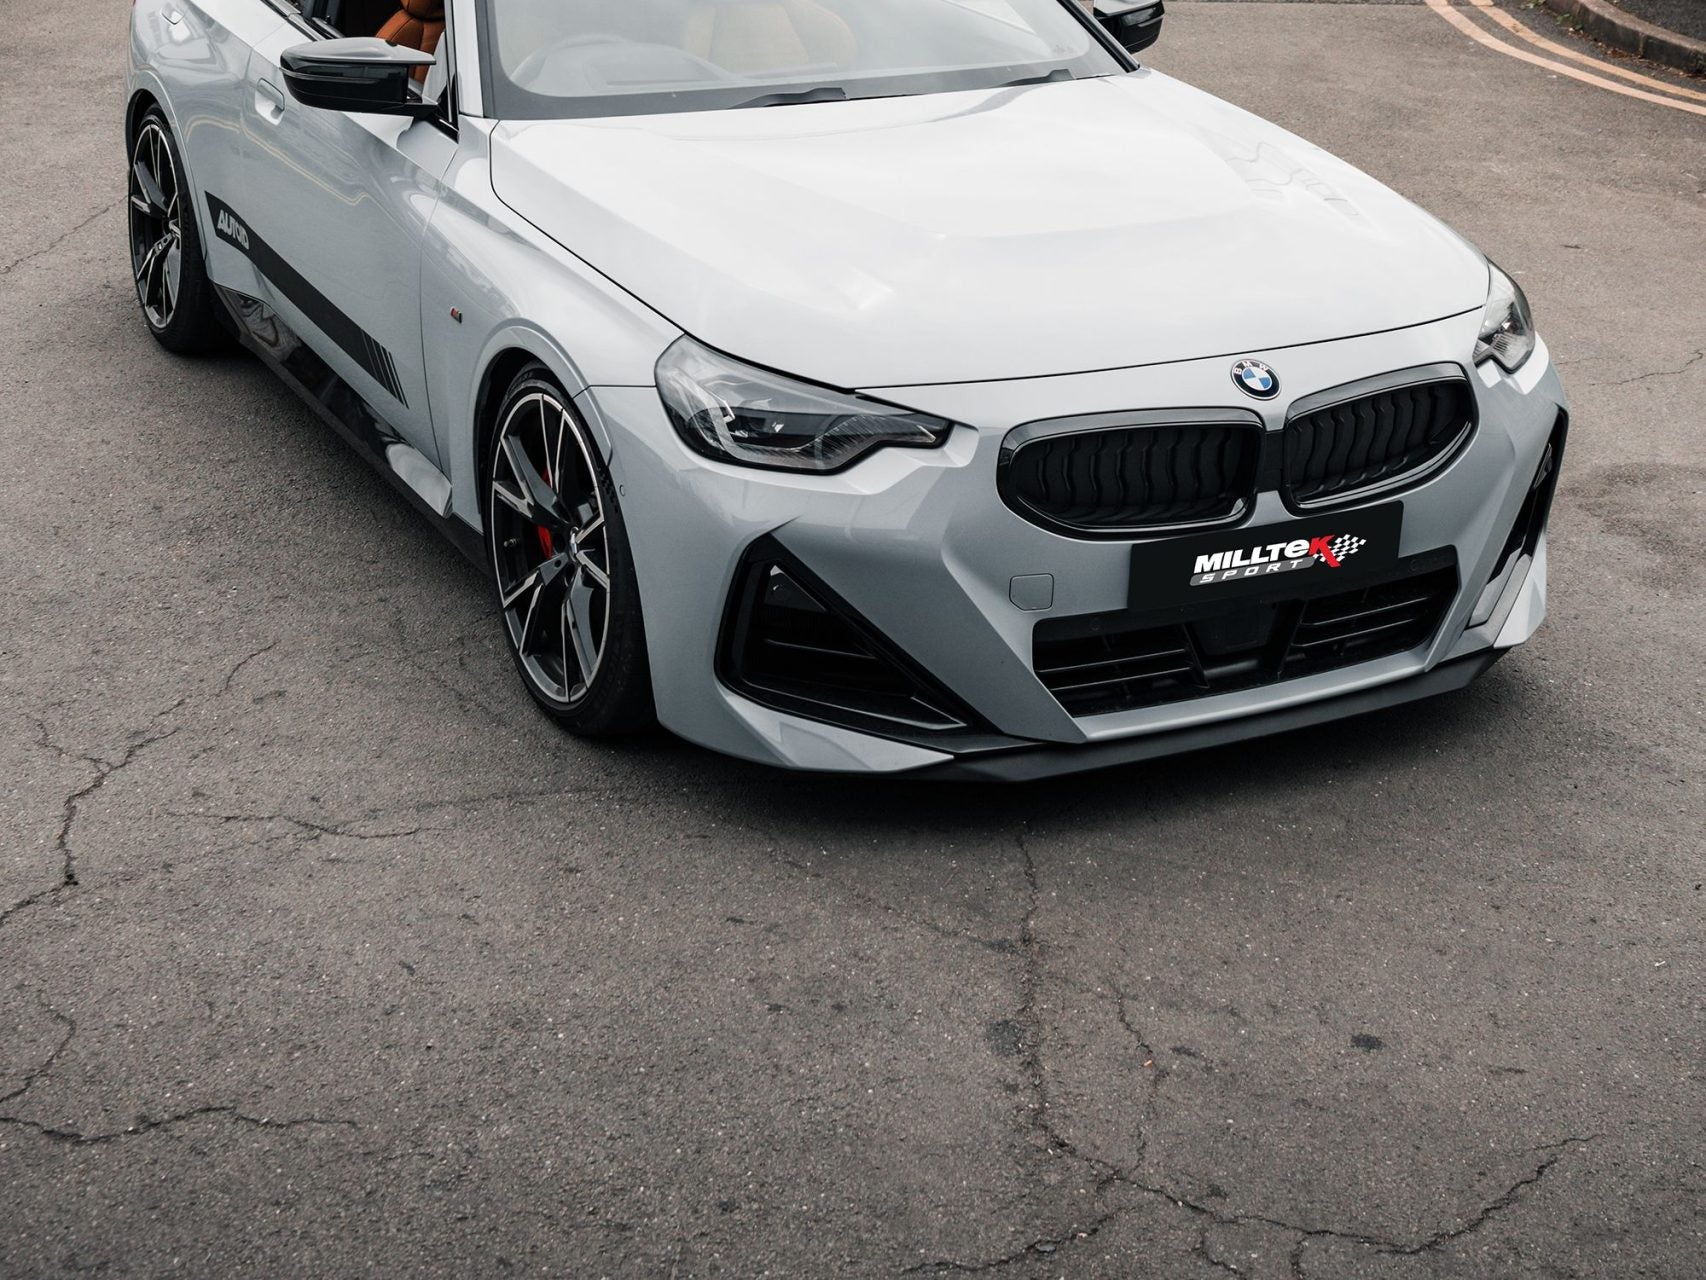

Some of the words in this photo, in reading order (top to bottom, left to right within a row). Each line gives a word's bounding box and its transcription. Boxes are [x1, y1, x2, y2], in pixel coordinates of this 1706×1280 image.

[217, 209, 250, 250] AUTOID
[1234, 360, 1269, 375] BMW
[1199, 559, 1304, 584] SPORT
